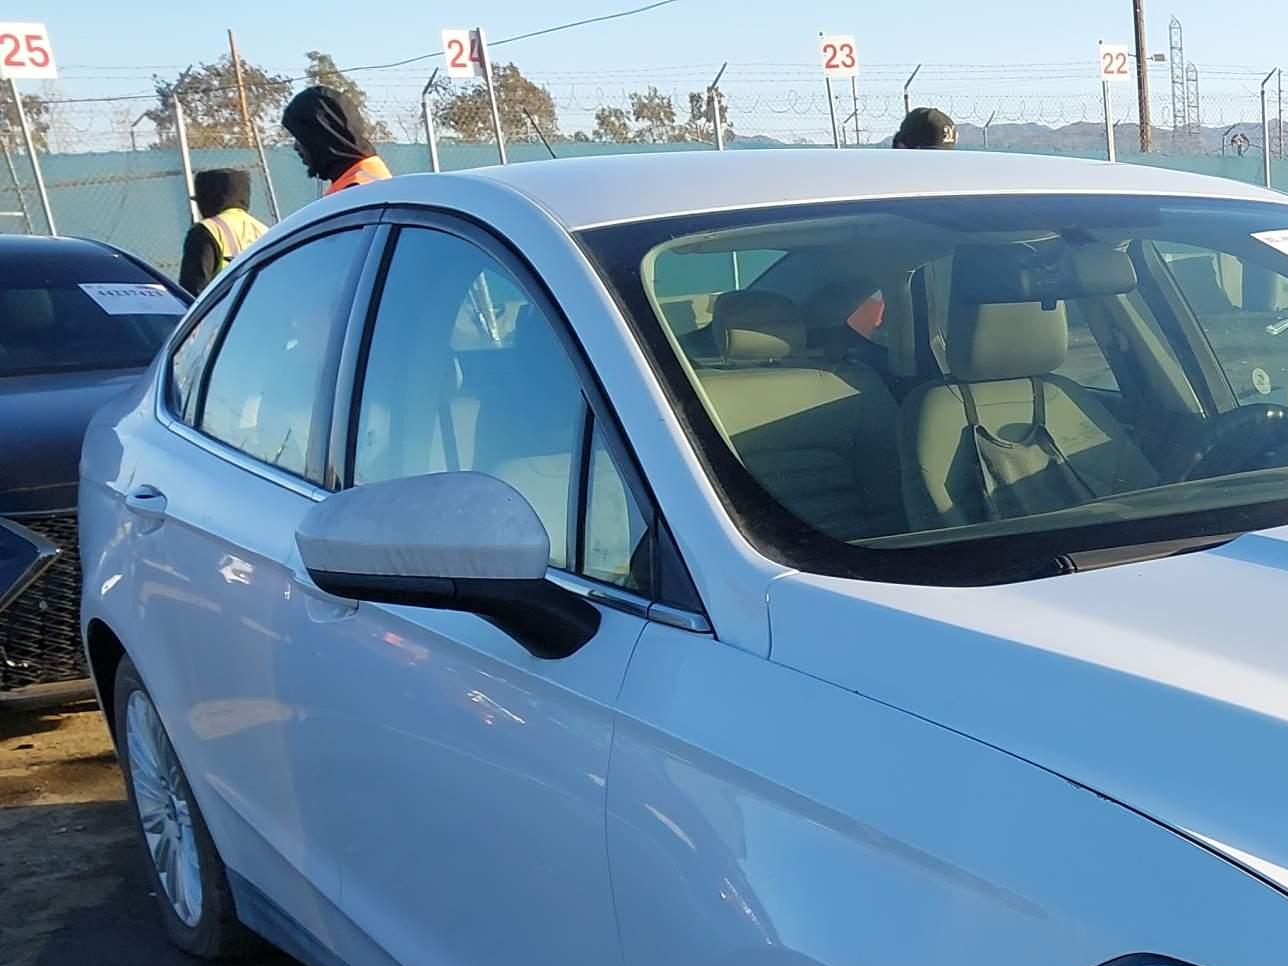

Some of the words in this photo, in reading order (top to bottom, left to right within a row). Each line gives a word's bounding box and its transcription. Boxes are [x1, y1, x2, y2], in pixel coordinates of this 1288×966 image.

[0, 33, 50, 68] 25
[823, 43, 855, 69] 23
[1103, 52, 1128, 74] 22
